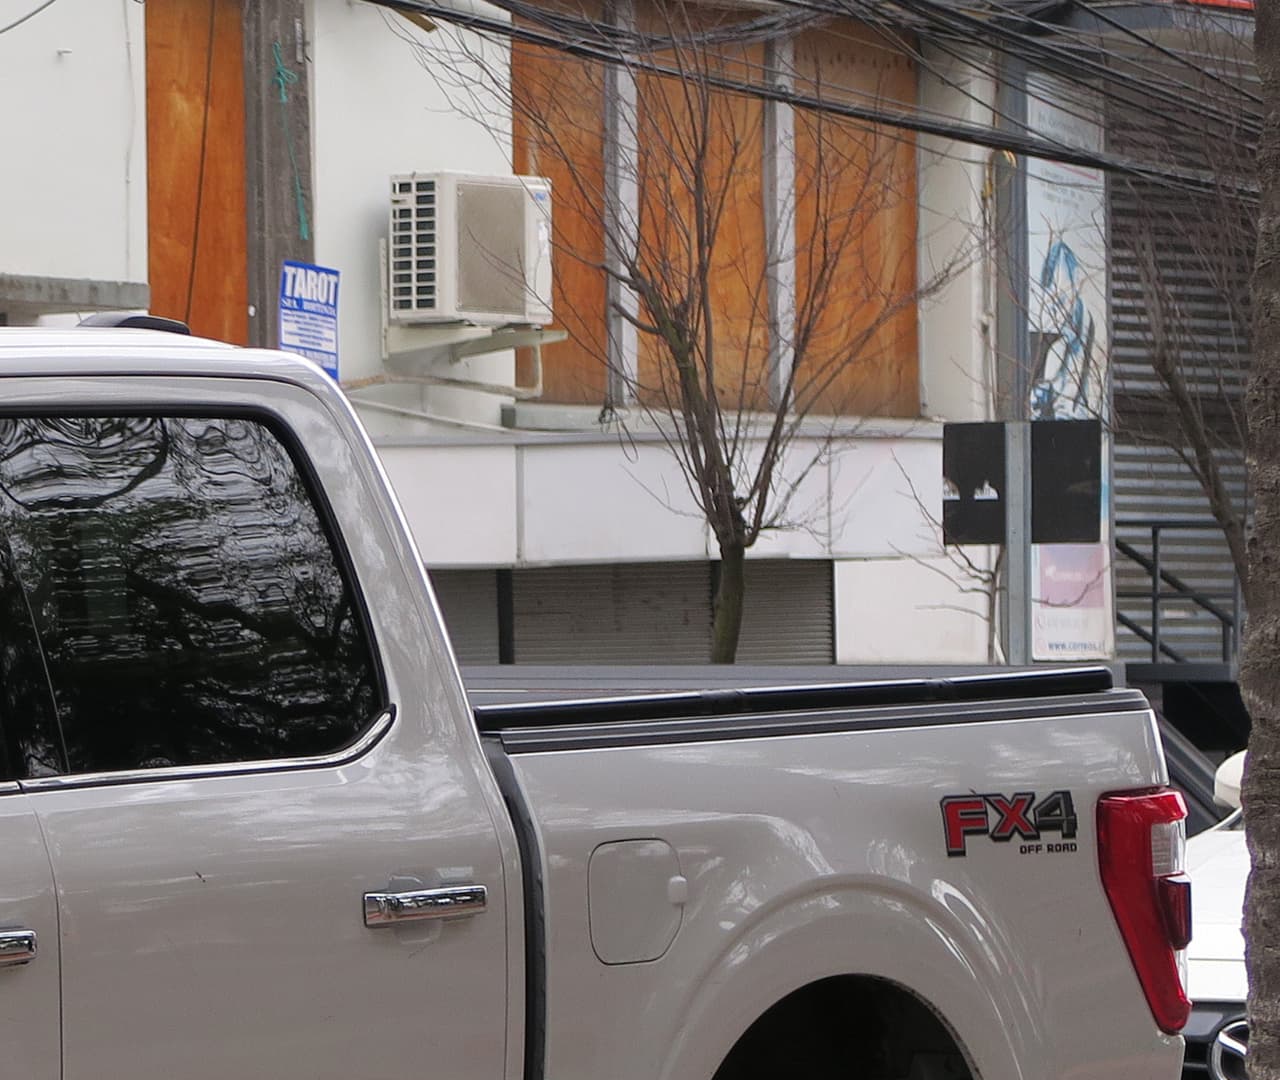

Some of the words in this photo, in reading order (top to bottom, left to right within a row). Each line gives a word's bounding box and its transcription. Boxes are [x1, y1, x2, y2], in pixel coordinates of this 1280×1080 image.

[283, 266, 338, 306] TAROT
[940, 790, 1078, 857] FX4
[1019, 844, 1043, 855] OFF
[1046, 843, 1078, 854] ROAD
